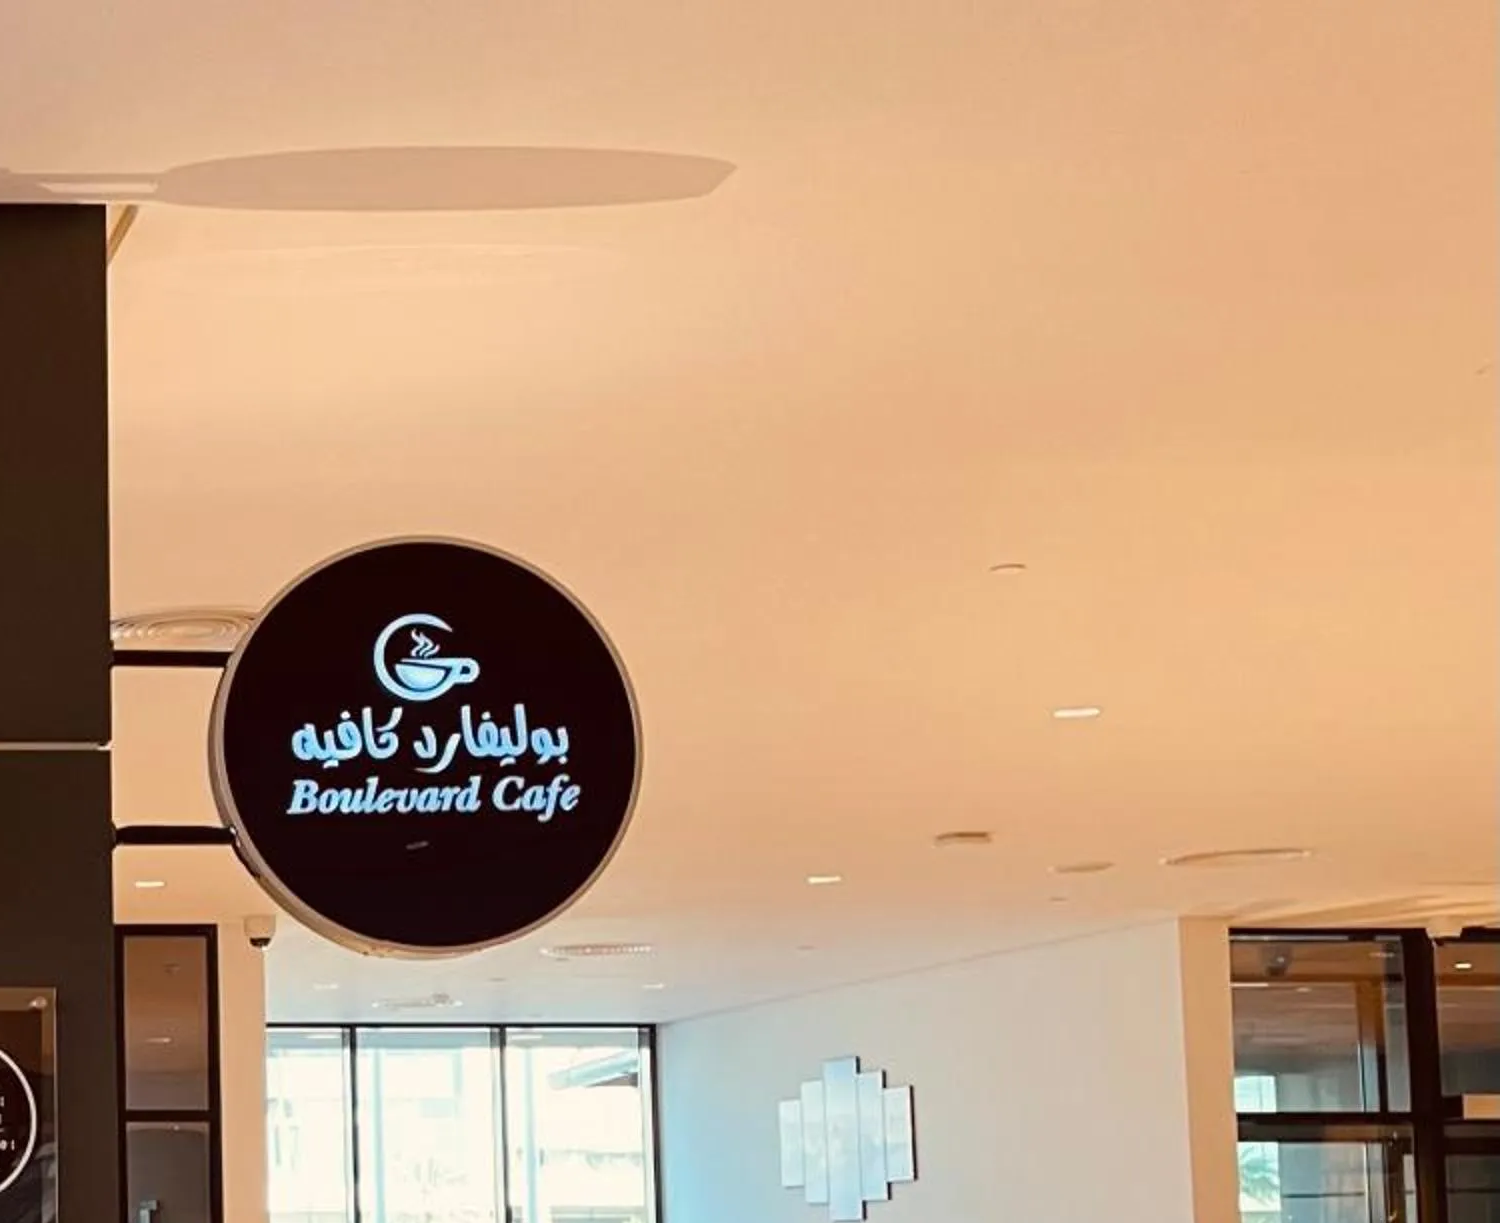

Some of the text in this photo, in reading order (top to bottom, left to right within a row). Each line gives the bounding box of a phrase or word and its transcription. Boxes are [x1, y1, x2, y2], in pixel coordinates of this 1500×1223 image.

[291, 703, 570, 774] بوليفارد كافيه
[286, 773, 581, 823] Boulevard Cafe
